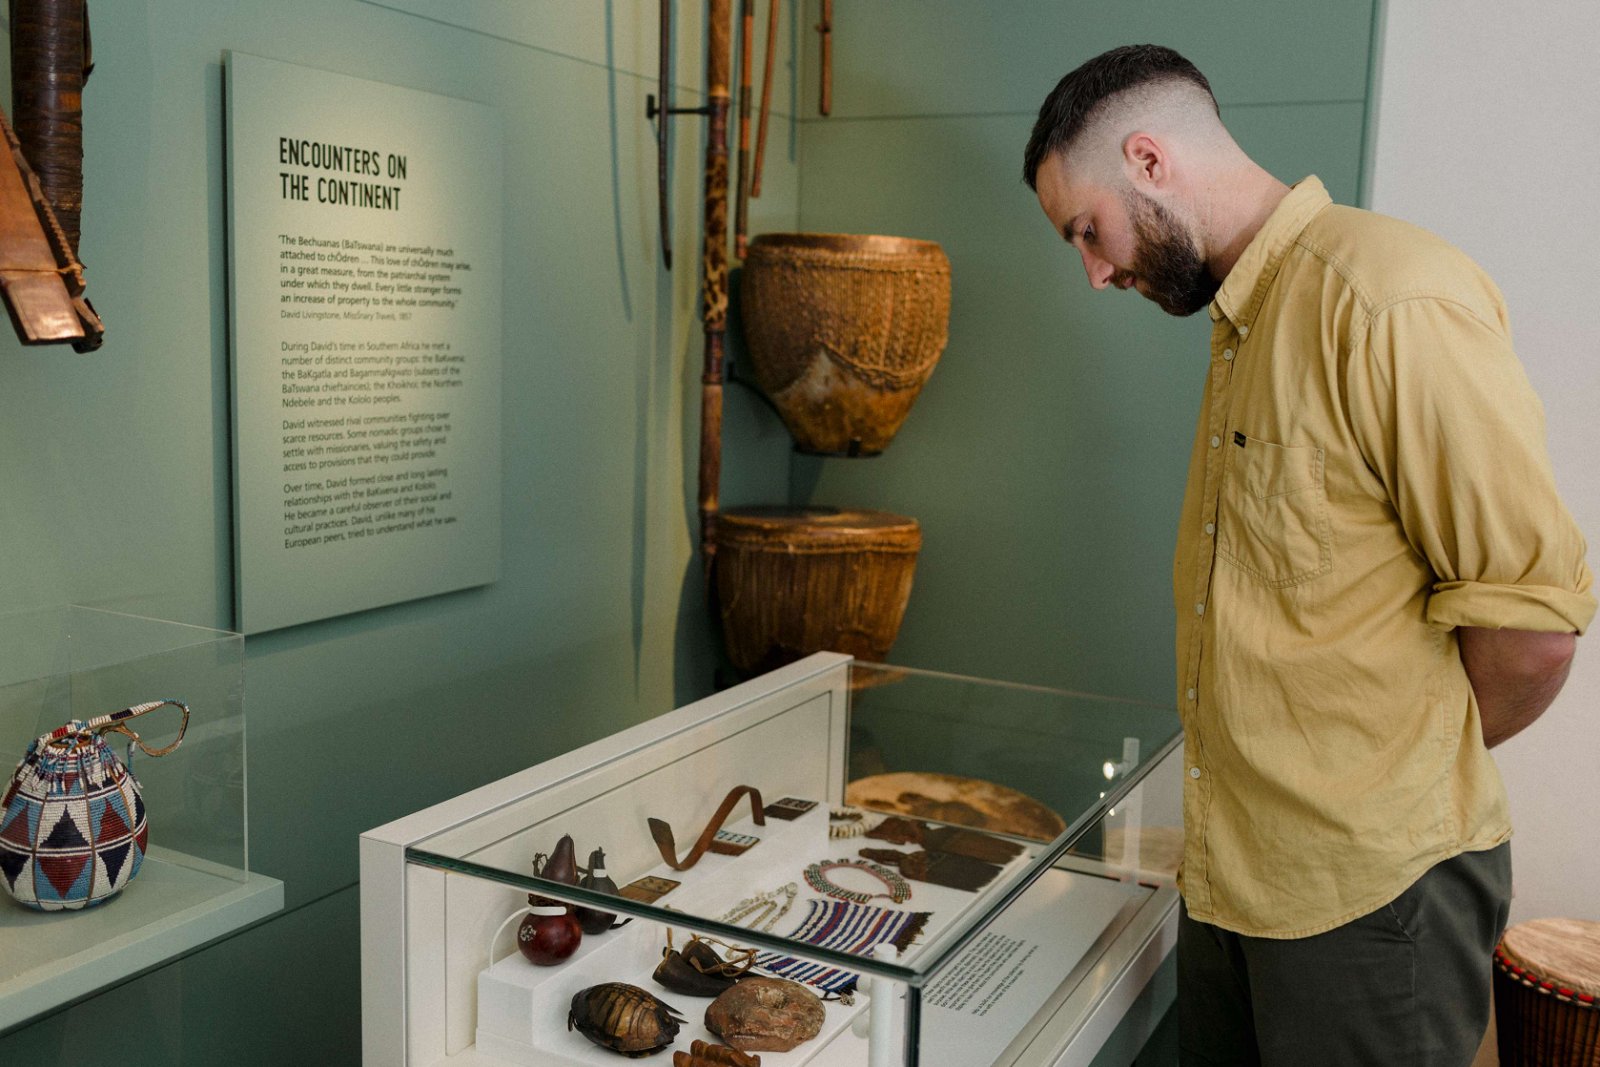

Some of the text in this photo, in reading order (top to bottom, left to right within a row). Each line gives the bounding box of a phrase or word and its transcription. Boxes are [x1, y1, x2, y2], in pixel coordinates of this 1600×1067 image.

[279, 136, 407, 180] ENCOUNTERS ON
[279, 173, 401, 211] THE CONTINENT
[299, 236, 339, 248] Bechuanas
[280, 251, 315, 260] attached
[318, 253, 325, 261] to
[280, 264, 288, 273] in
[298, 267, 318, 276] great
[357, 268, 375, 277] from
[281, 279, 304, 288] under
[307, 280, 330, 289] which
[333, 281, 349, 292] they
[294, 294, 325, 303] increase
[328, 295, 335, 304] of
[337, 297, 370, 307] property
[281, 310, 300, 318] David
[282, 341, 308, 353] During
[311, 341, 337, 351] David's
[367, 342, 398, 351] Southern
[282, 356, 312, 365] number
[315, 355, 323, 365] of
[326, 355, 352, 364] distinct
[355, 356, 393, 365] community
[282, 370, 295, 379] the
[334, 369, 347, 378] and
[282, 384, 320, 394] BaTswana
[283, 397, 315, 408] Ndebele
[317, 397, 331, 406] and
[334, 397, 346, 405] the
[283, 419, 304, 430] David
[307, 418, 344, 427] witnessed
[347, 416, 361, 425] rival
[363, 415, 407, 424] communities
[283, 435, 306, 444] scarce
[309, 433, 344, 441] resources.
[347, 430, 367, 439] Some
[369, 427, 398, 437] nomadic
[283, 448, 305, 458] settle
[307, 446, 324, 455] with
[326, 444, 371, 453] missionaries,
[284, 463, 306, 472] access
[309, 461, 317, 469] to
[319, 458, 356, 469] provisions
[358, 456, 372, 464] that
[284, 484, 302, 493] Over
[305, 483, 324, 491] time,
[326, 478, 347, 489] David
[350, 476, 375, 486] formed
[284, 495, 332, 507] relationships
[334, 491, 350, 500] with
[353, 490, 364, 498] the
[367, 487, 398, 497] BaKwena
[285, 512, 295, 520] He
[297, 509, 327, 519] became
[337, 503, 361, 514] careful
[363, 501, 392, 510] observer
[285, 522, 313, 535] cultural
[285, 537, 322, 549] European
[348, 528, 365, 539] tried
[367, 528, 374, 536] to
